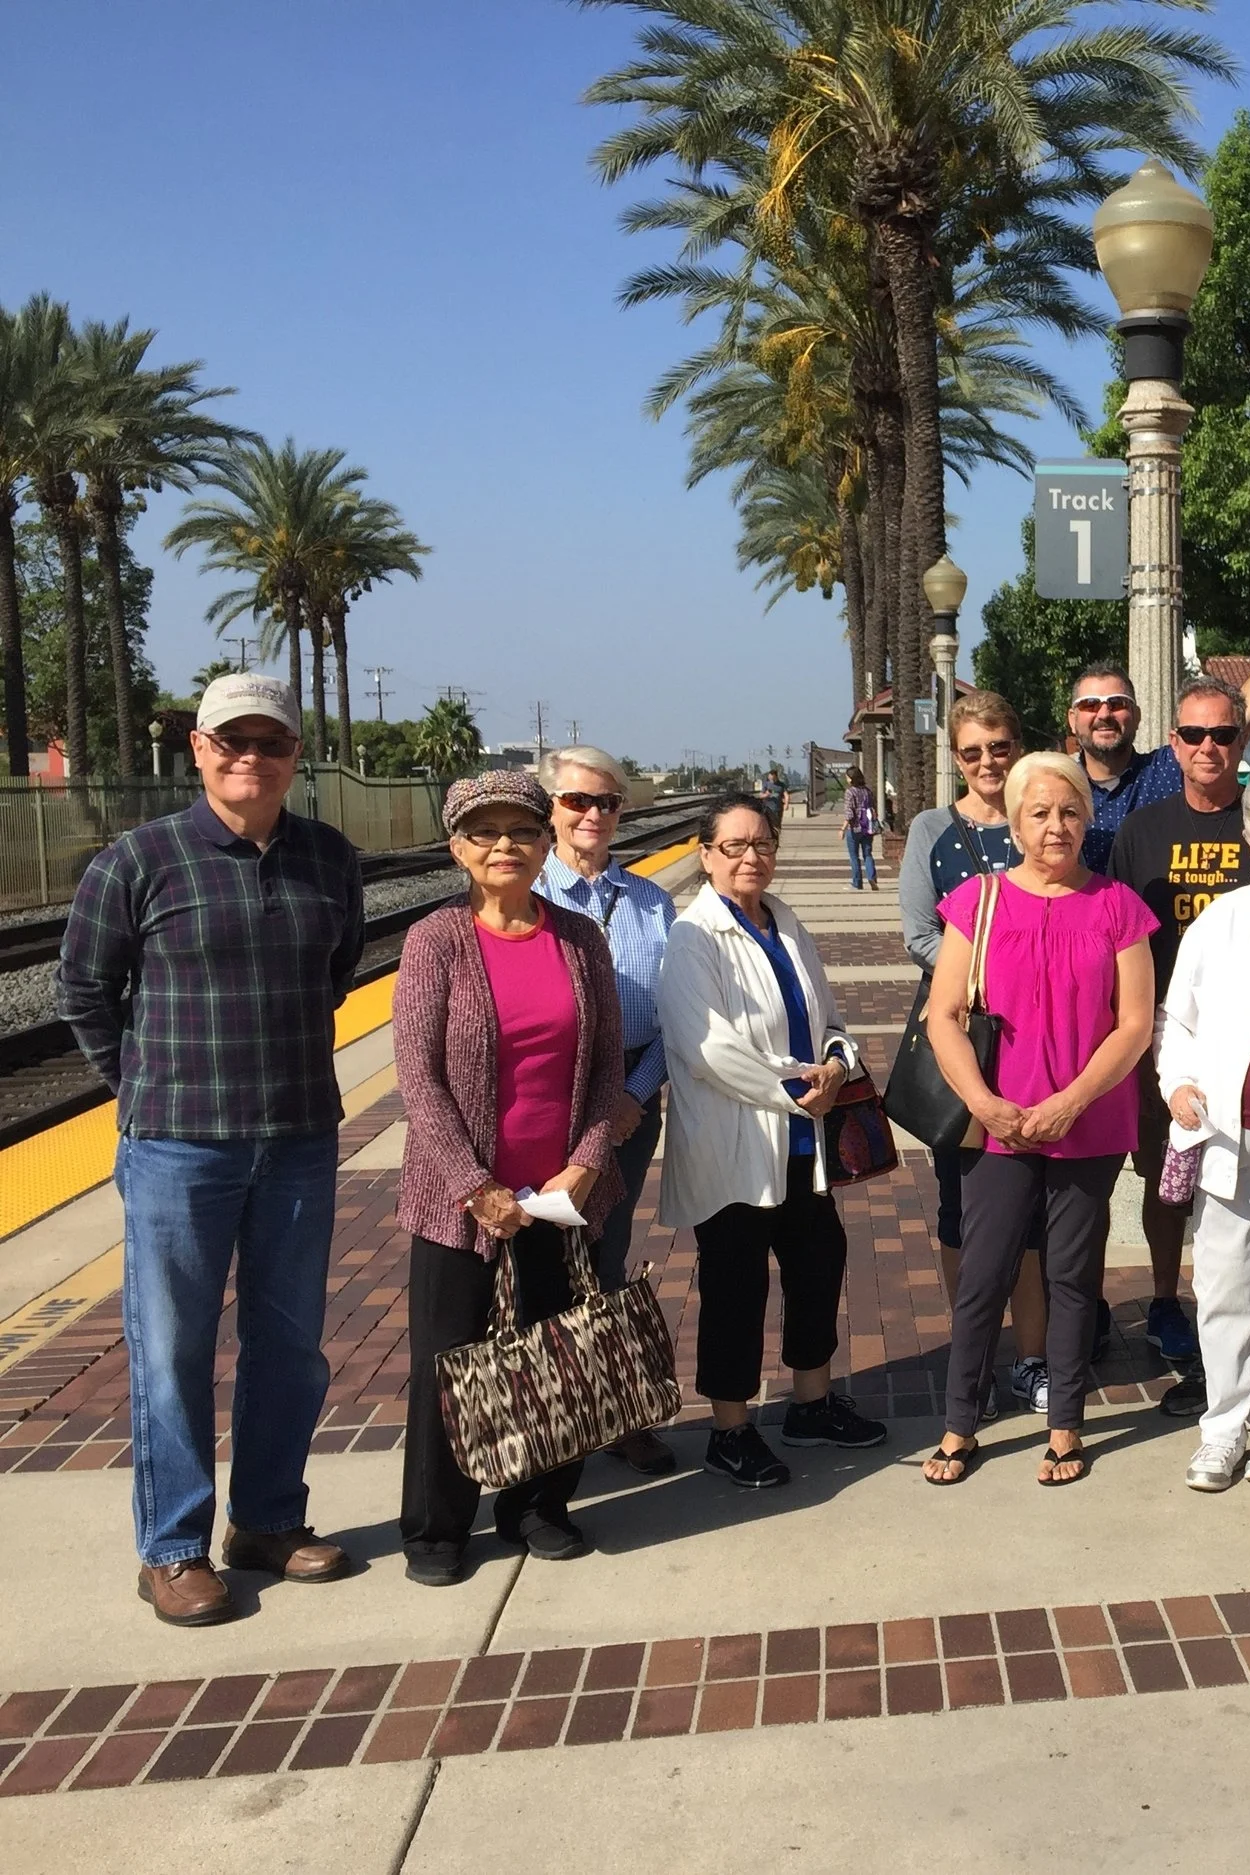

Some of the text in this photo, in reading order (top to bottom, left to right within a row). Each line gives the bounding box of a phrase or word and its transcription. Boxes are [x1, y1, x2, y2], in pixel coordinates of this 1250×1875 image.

[1048, 488, 1115, 511] Track
[1069, 519, 1092, 584] 1
[923, 714, 930, 730] 1
[1170, 843, 1241, 870] LIFE
[1168, 871, 1238, 886] is tough...
[1174, 893, 1221, 921] GO
[13, 1298, 88, 1329] LINE
